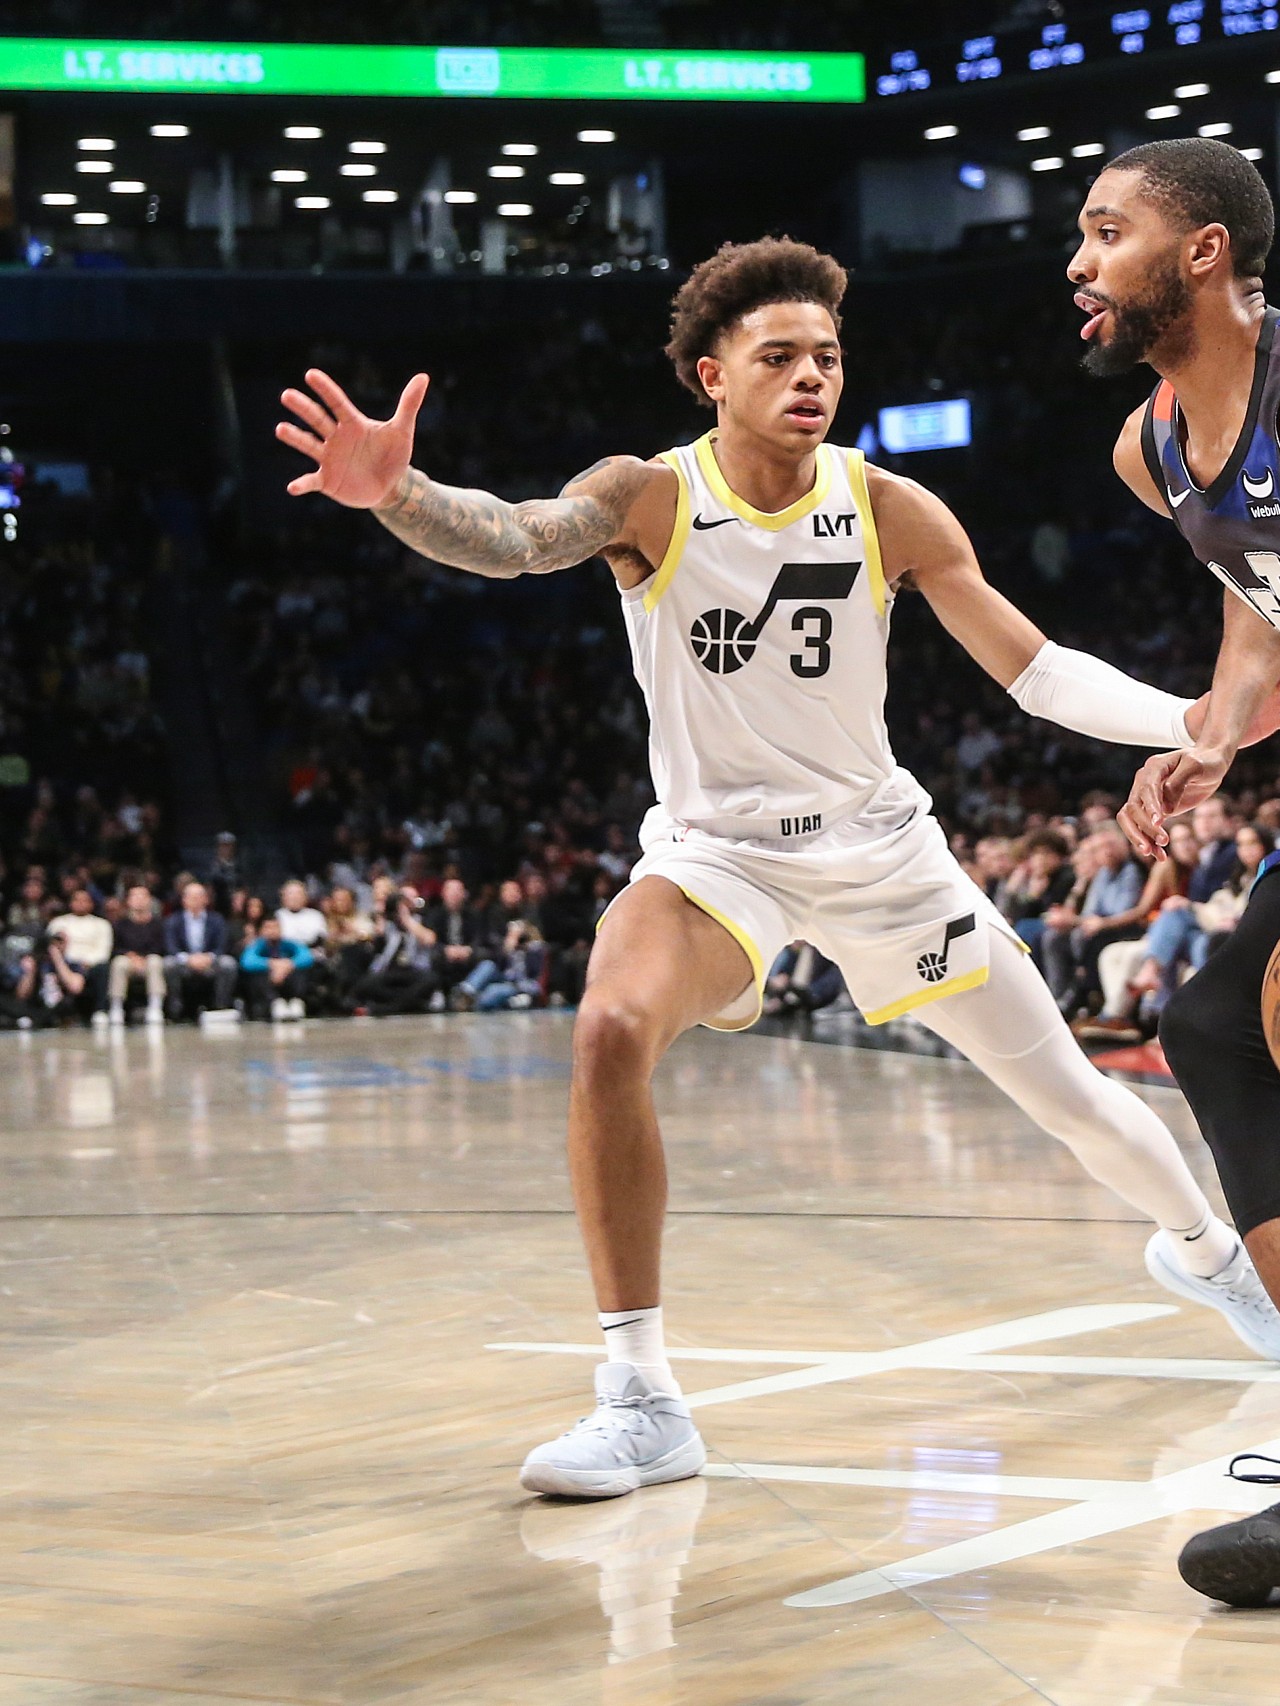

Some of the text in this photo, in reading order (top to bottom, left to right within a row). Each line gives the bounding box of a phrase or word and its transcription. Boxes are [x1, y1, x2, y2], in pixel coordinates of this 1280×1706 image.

[119, 52, 264, 83] SERVICES
[676, 60, 812, 91] SERVICES
[813, 513, 856, 537] LVT
[790, 606, 832, 678] 3
